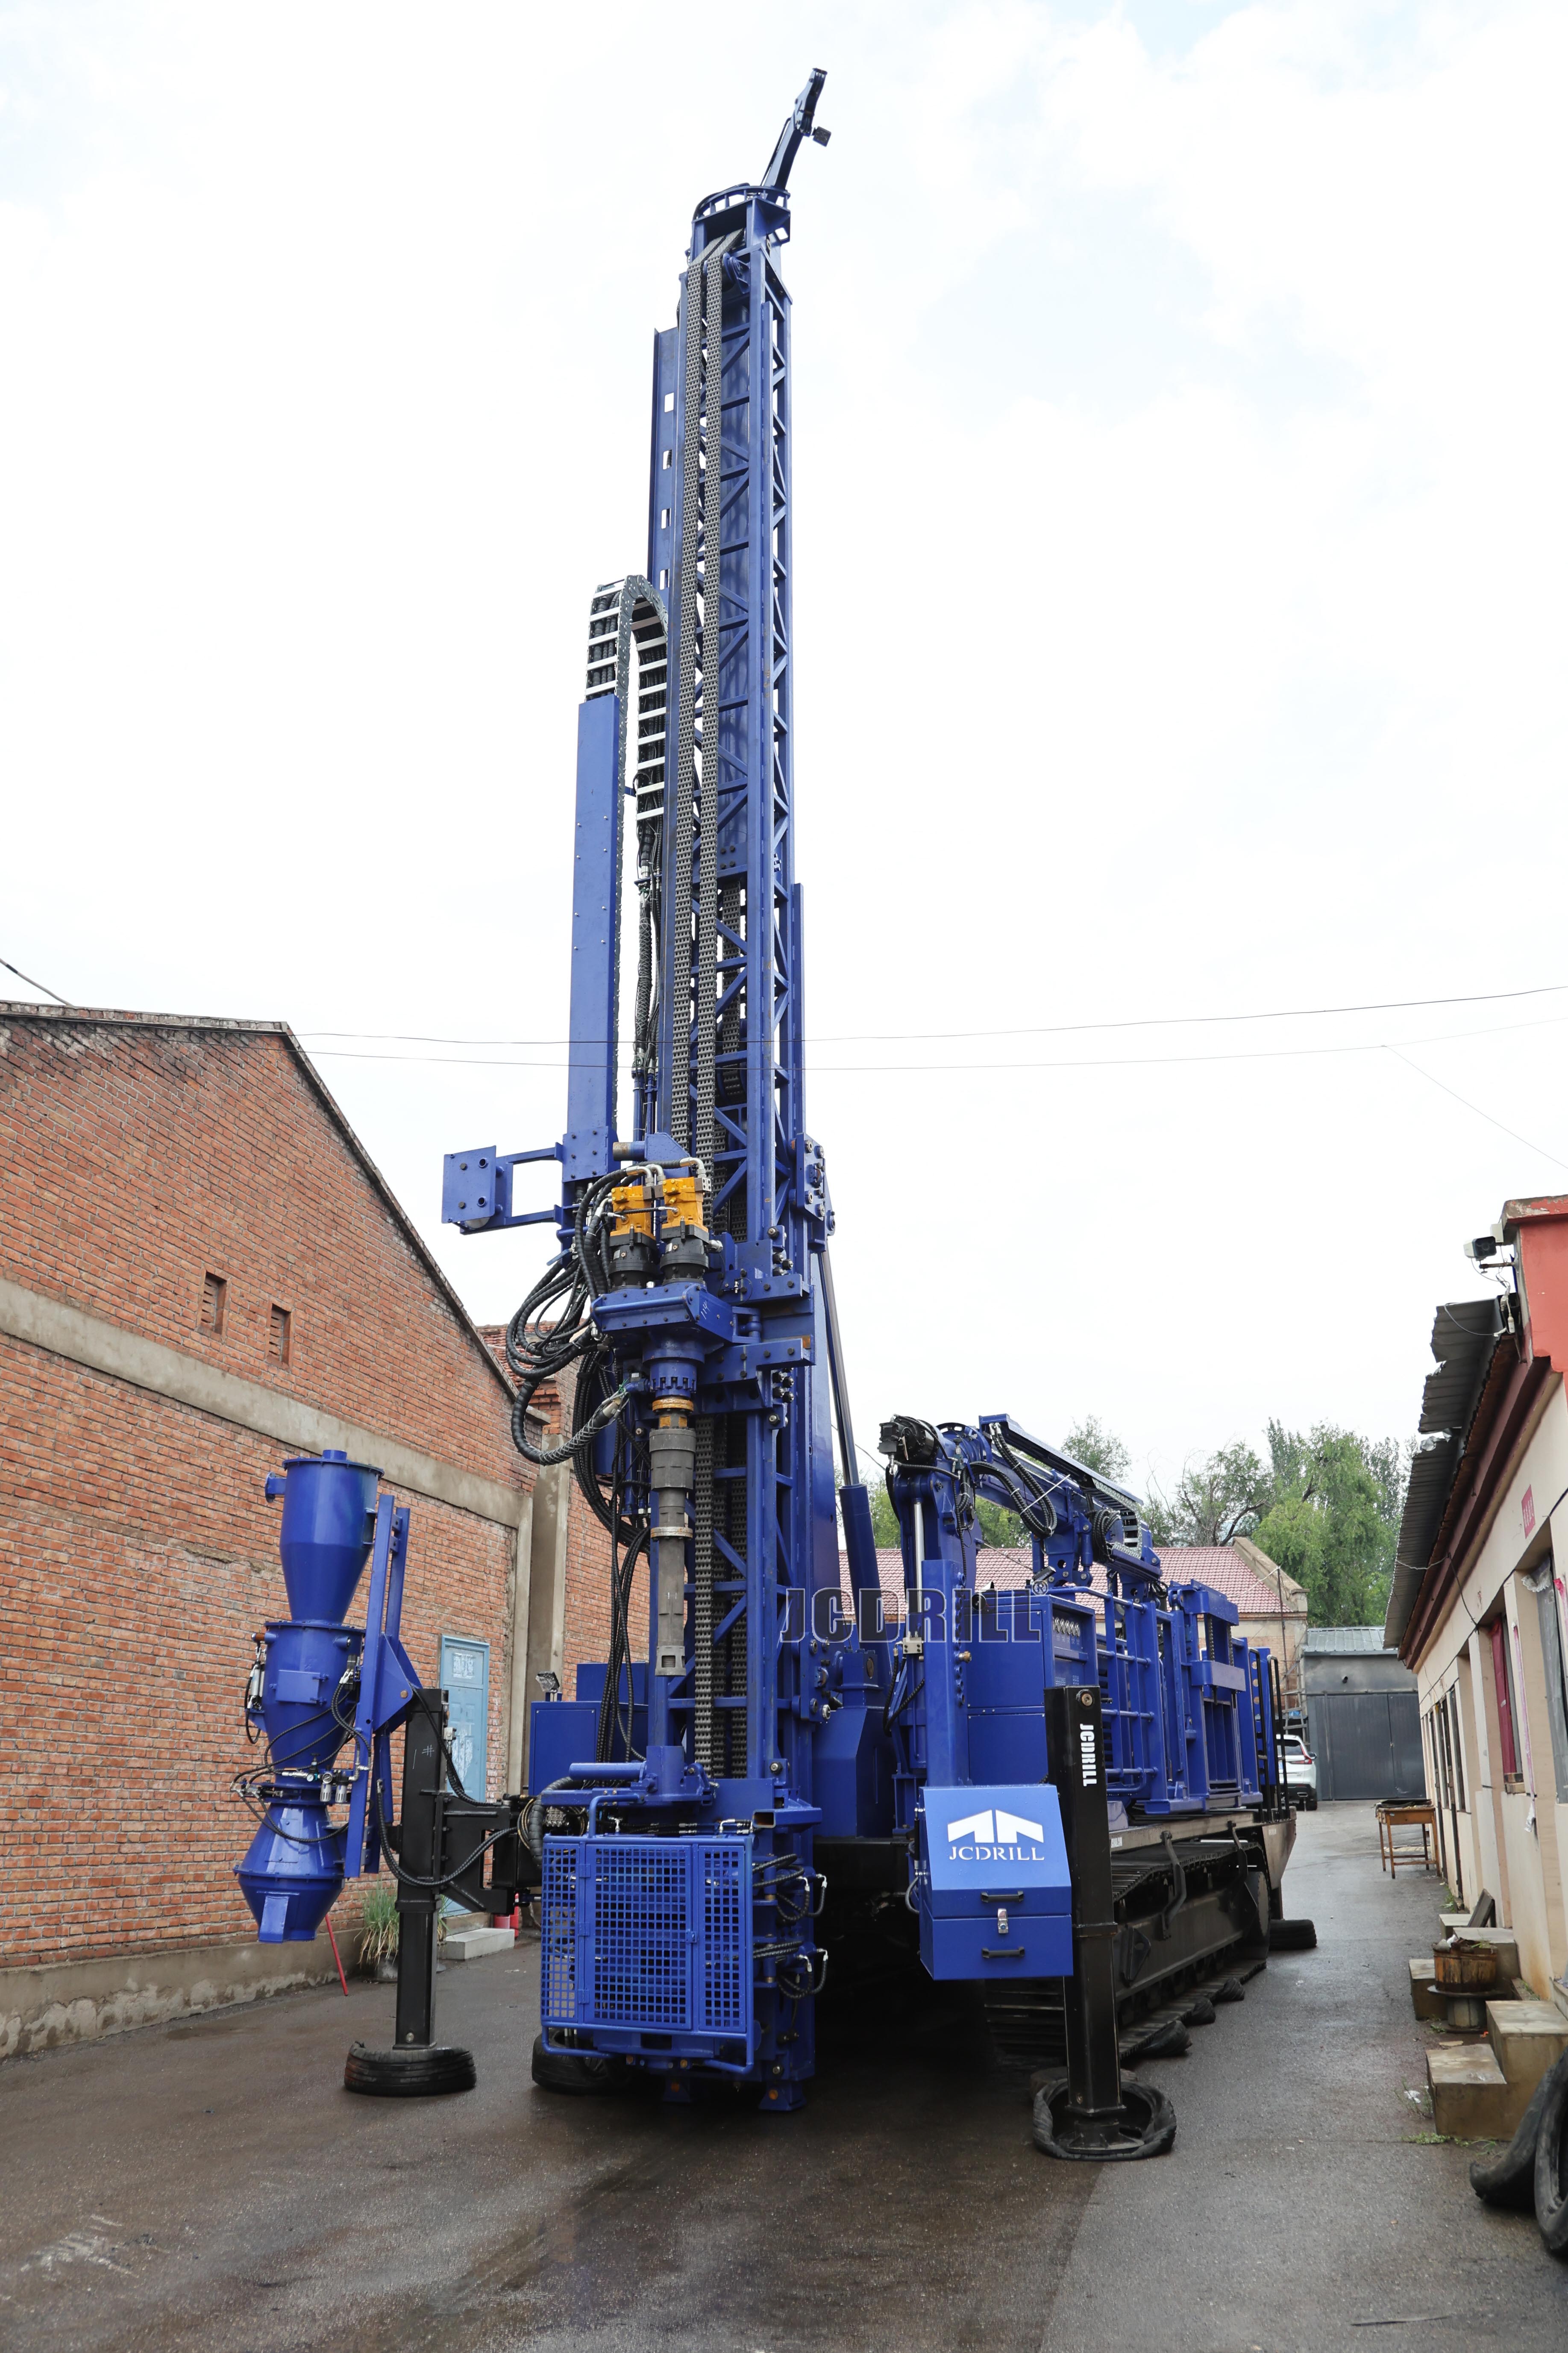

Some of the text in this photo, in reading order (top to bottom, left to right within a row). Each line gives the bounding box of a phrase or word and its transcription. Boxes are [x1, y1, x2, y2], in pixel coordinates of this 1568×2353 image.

[701, 1300, 711, 1320] 114
[1080, 1723, 1097, 1787] JCDRILL
[949, 1846, 1045, 1861] JCDRILL
